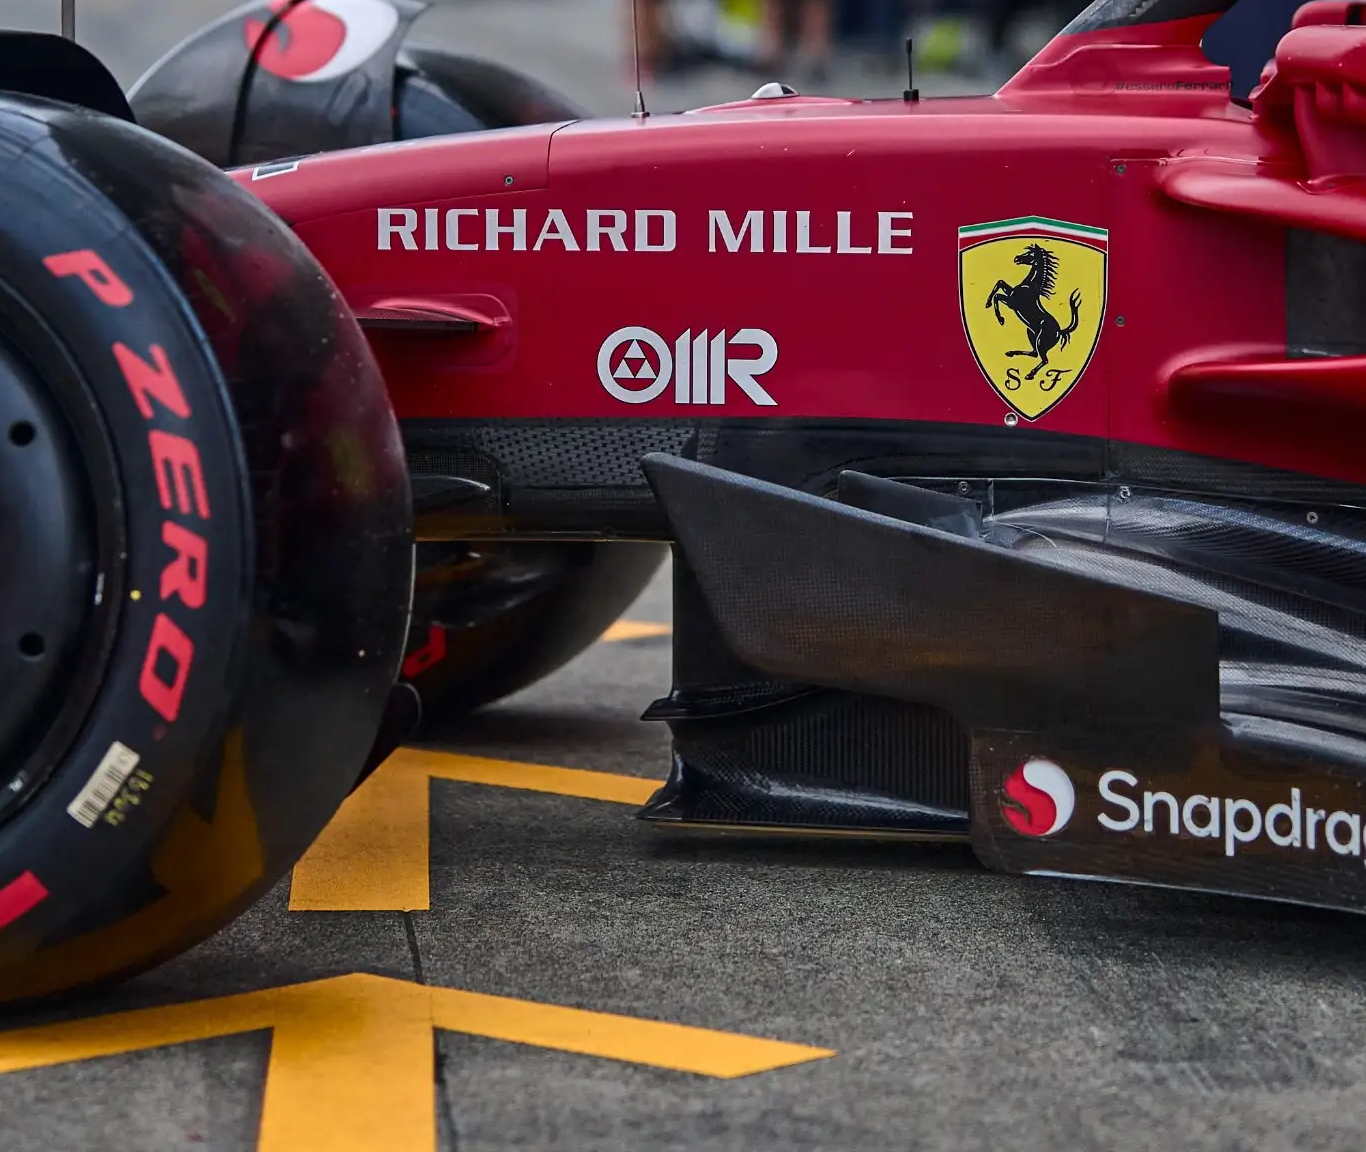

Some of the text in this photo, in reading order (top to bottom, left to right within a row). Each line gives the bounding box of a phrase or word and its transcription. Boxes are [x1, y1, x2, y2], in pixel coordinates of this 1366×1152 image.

[377, 207, 914, 255] RICHARD MILLE
[1004, 367, 1023, 392] S
[112, 341, 211, 723] ZERO
